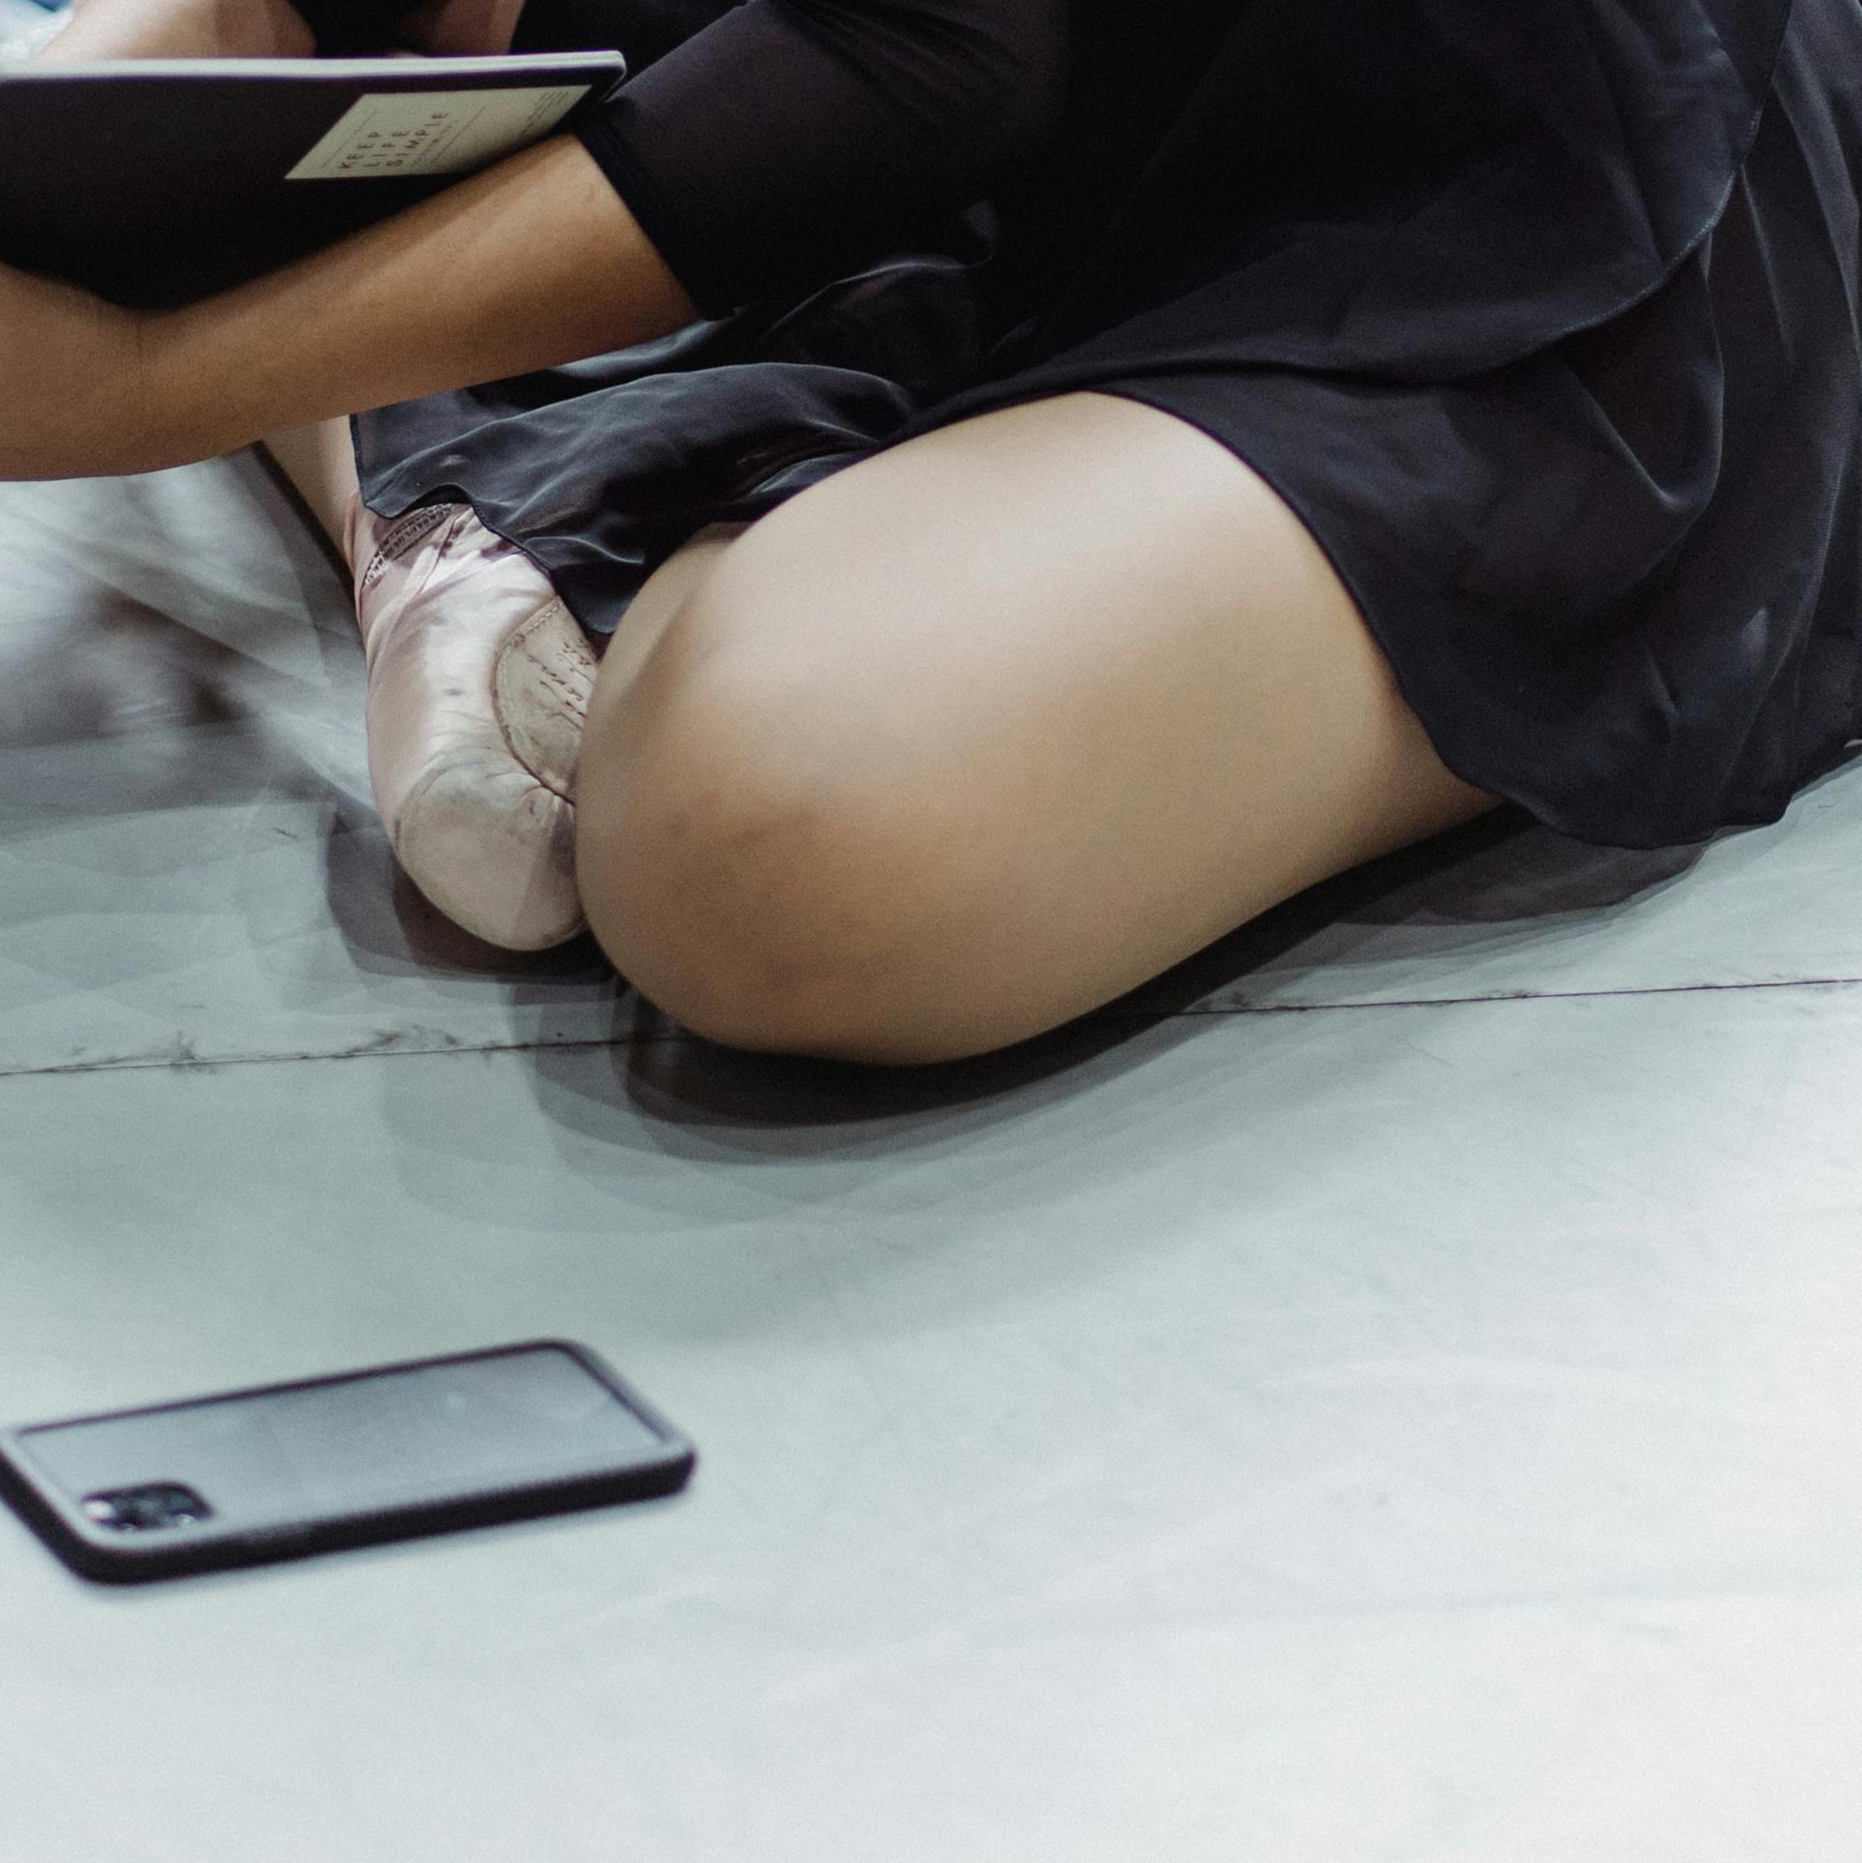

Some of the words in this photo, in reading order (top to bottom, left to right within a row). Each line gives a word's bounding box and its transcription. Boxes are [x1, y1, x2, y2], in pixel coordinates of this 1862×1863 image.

[338, 131, 382, 169] KEEP
[362, 131, 410, 168] LIFE
[385, 112, 450, 168] SIMPLE
